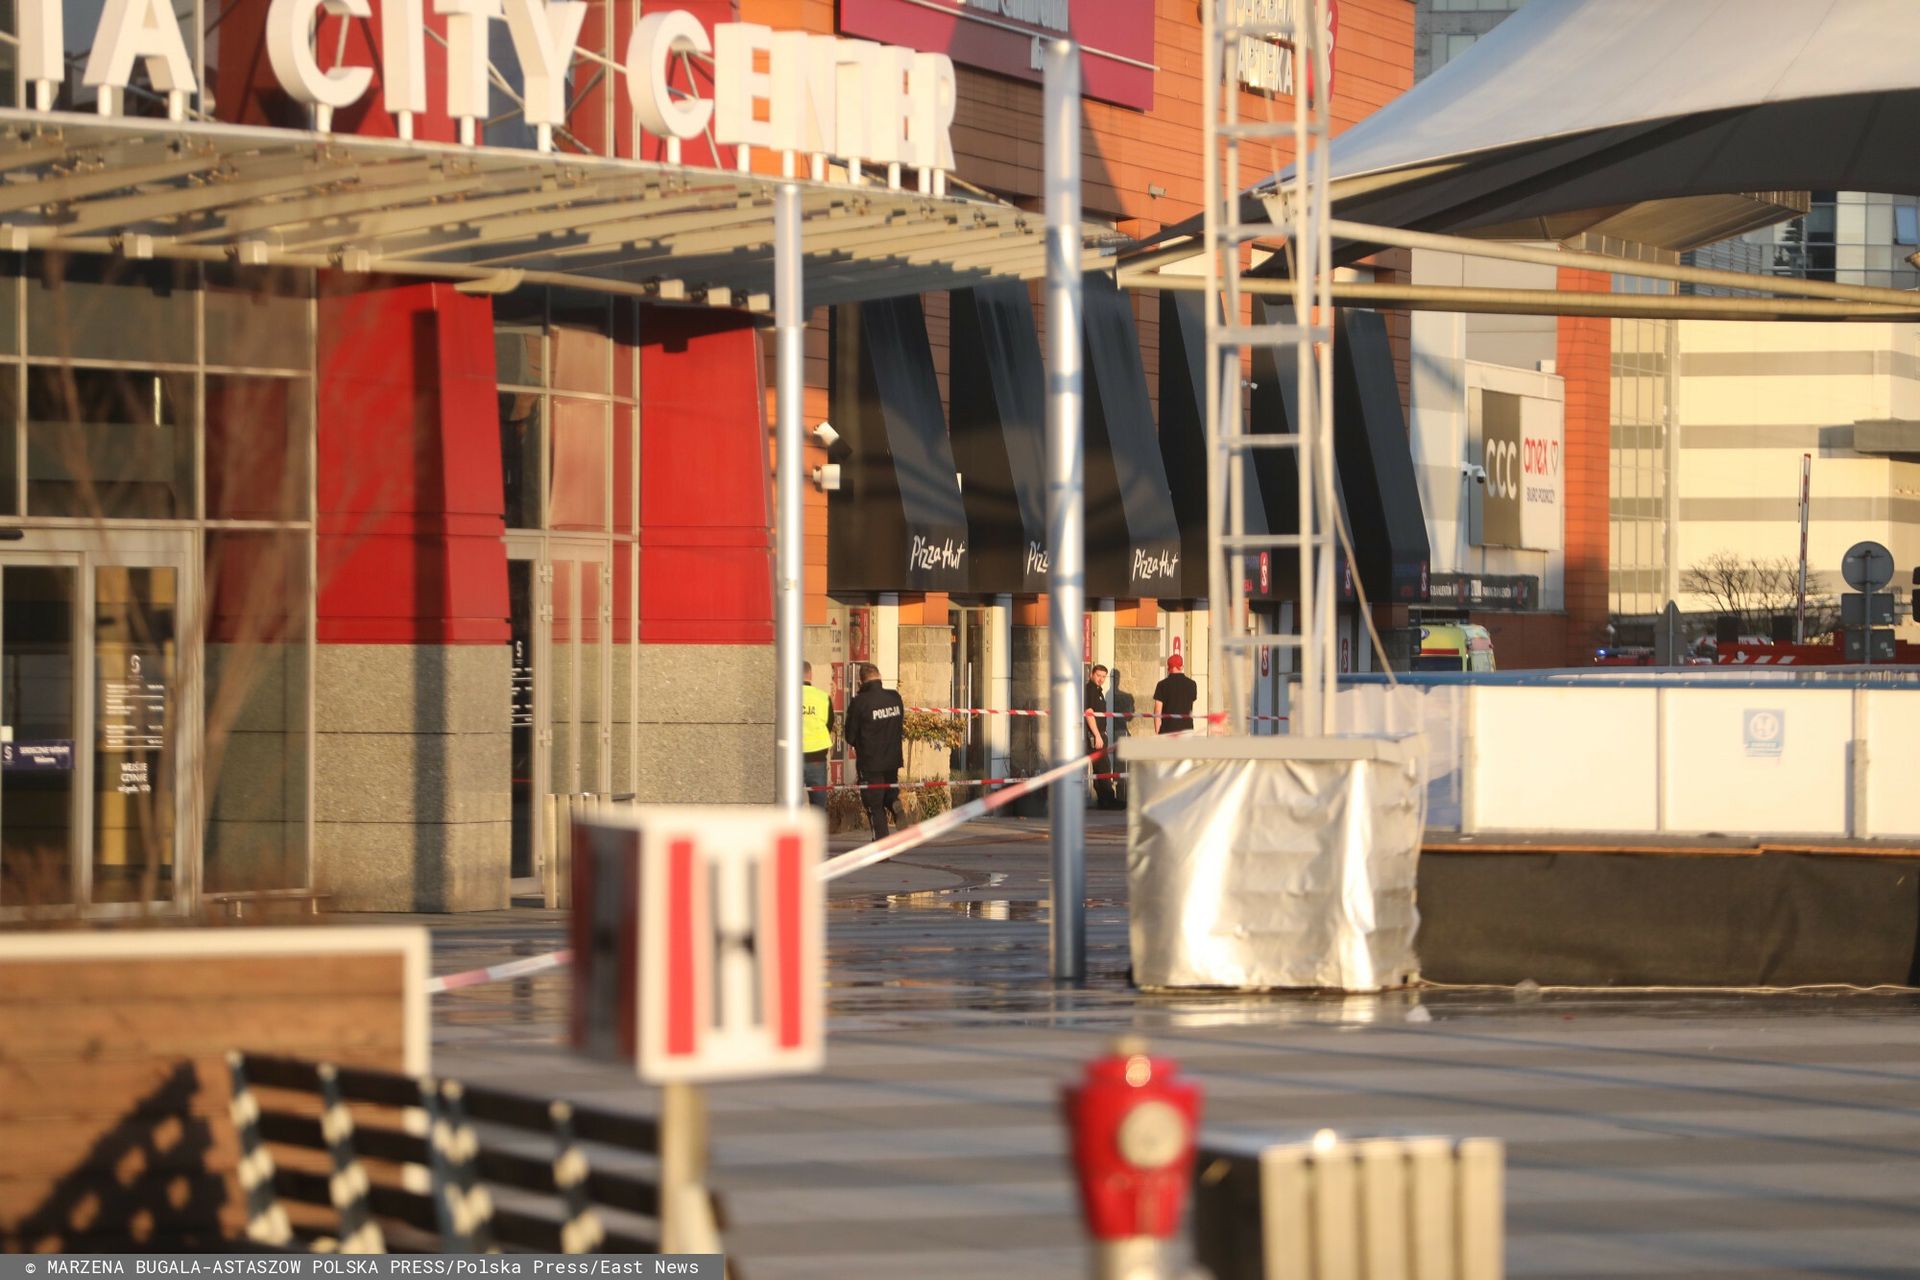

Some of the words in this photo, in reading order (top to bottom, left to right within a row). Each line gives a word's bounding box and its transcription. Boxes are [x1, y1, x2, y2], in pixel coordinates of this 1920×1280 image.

[266, 0, 588, 126] CITY
[626, 10, 957, 171] CENTER
[1486, 437, 1517, 500] CCC
[910, 535, 941, 572] Pizza
[942, 538, 965, 570] Hut
[1026, 541, 1049, 575] Pizz
[1132, 548, 1158, 583] Pizza
[1159, 549, 1178, 578] Hut
[872, 706, 900, 720] POLICJA
